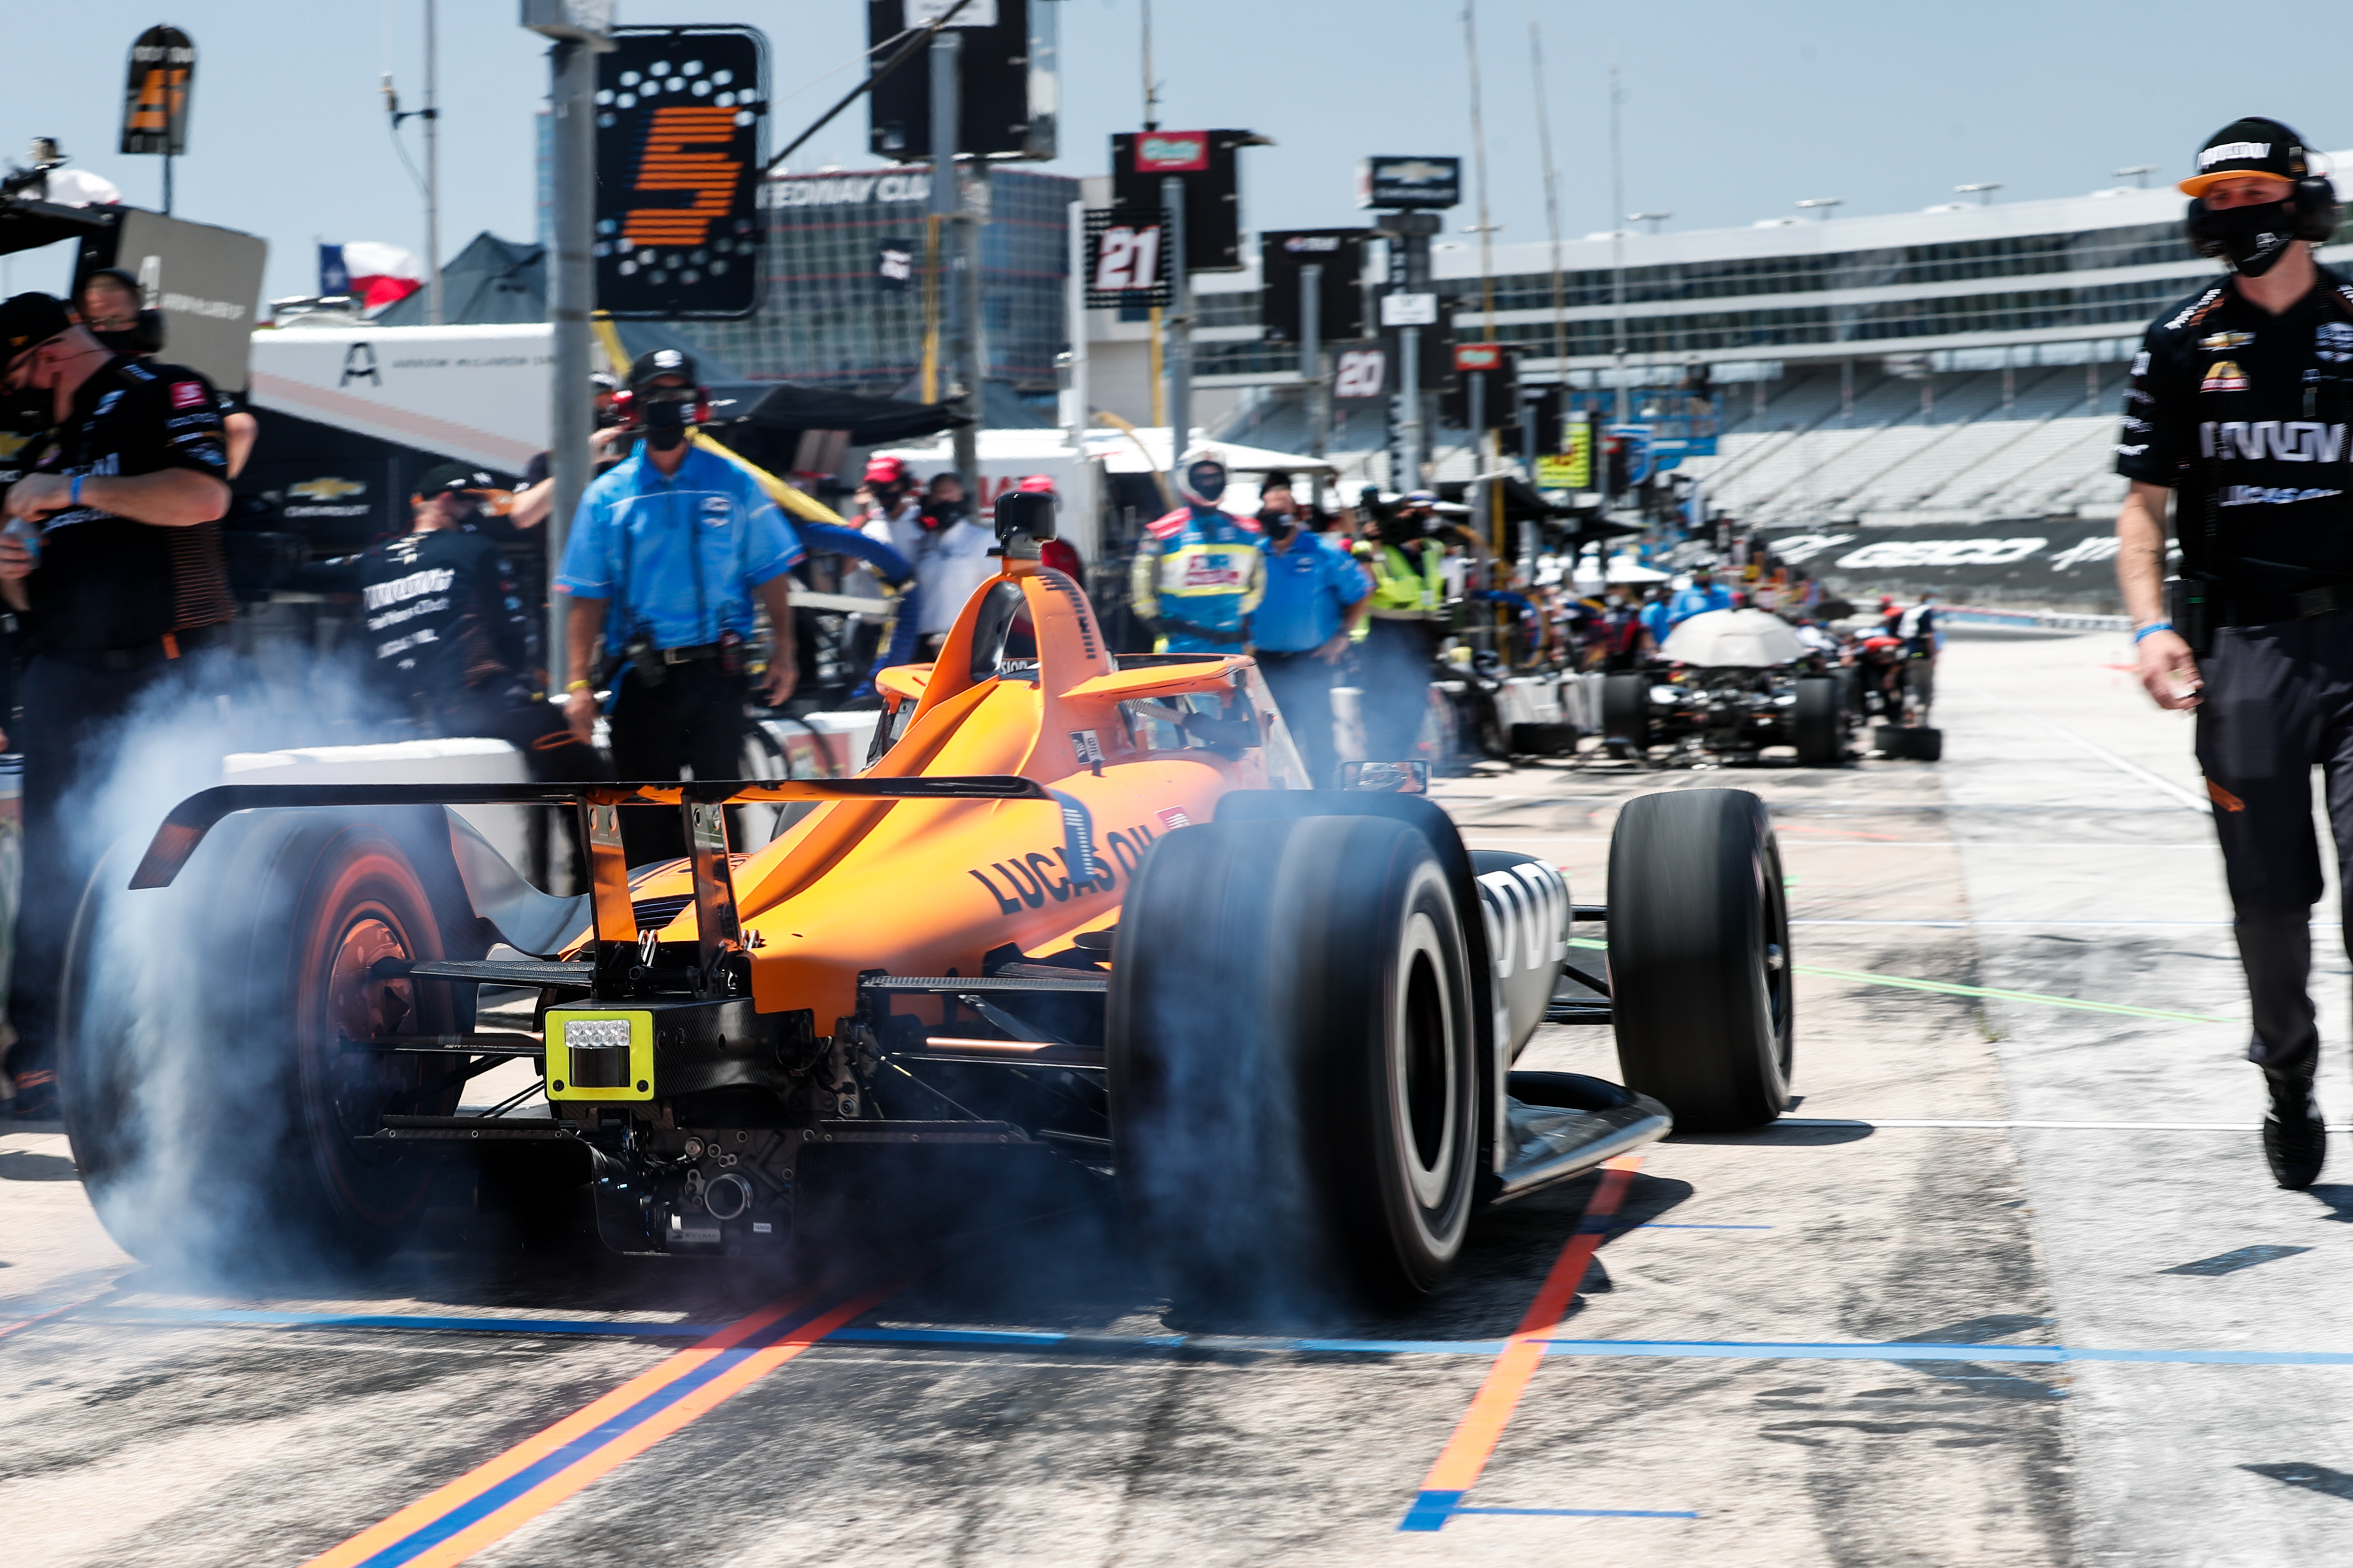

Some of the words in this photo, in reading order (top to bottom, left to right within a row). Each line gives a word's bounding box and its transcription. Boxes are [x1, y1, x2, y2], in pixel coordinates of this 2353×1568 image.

[622, 105, 745, 246] 5
[1094, 223, 1162, 291] 21
[1333, 349, 1386, 398] 20
